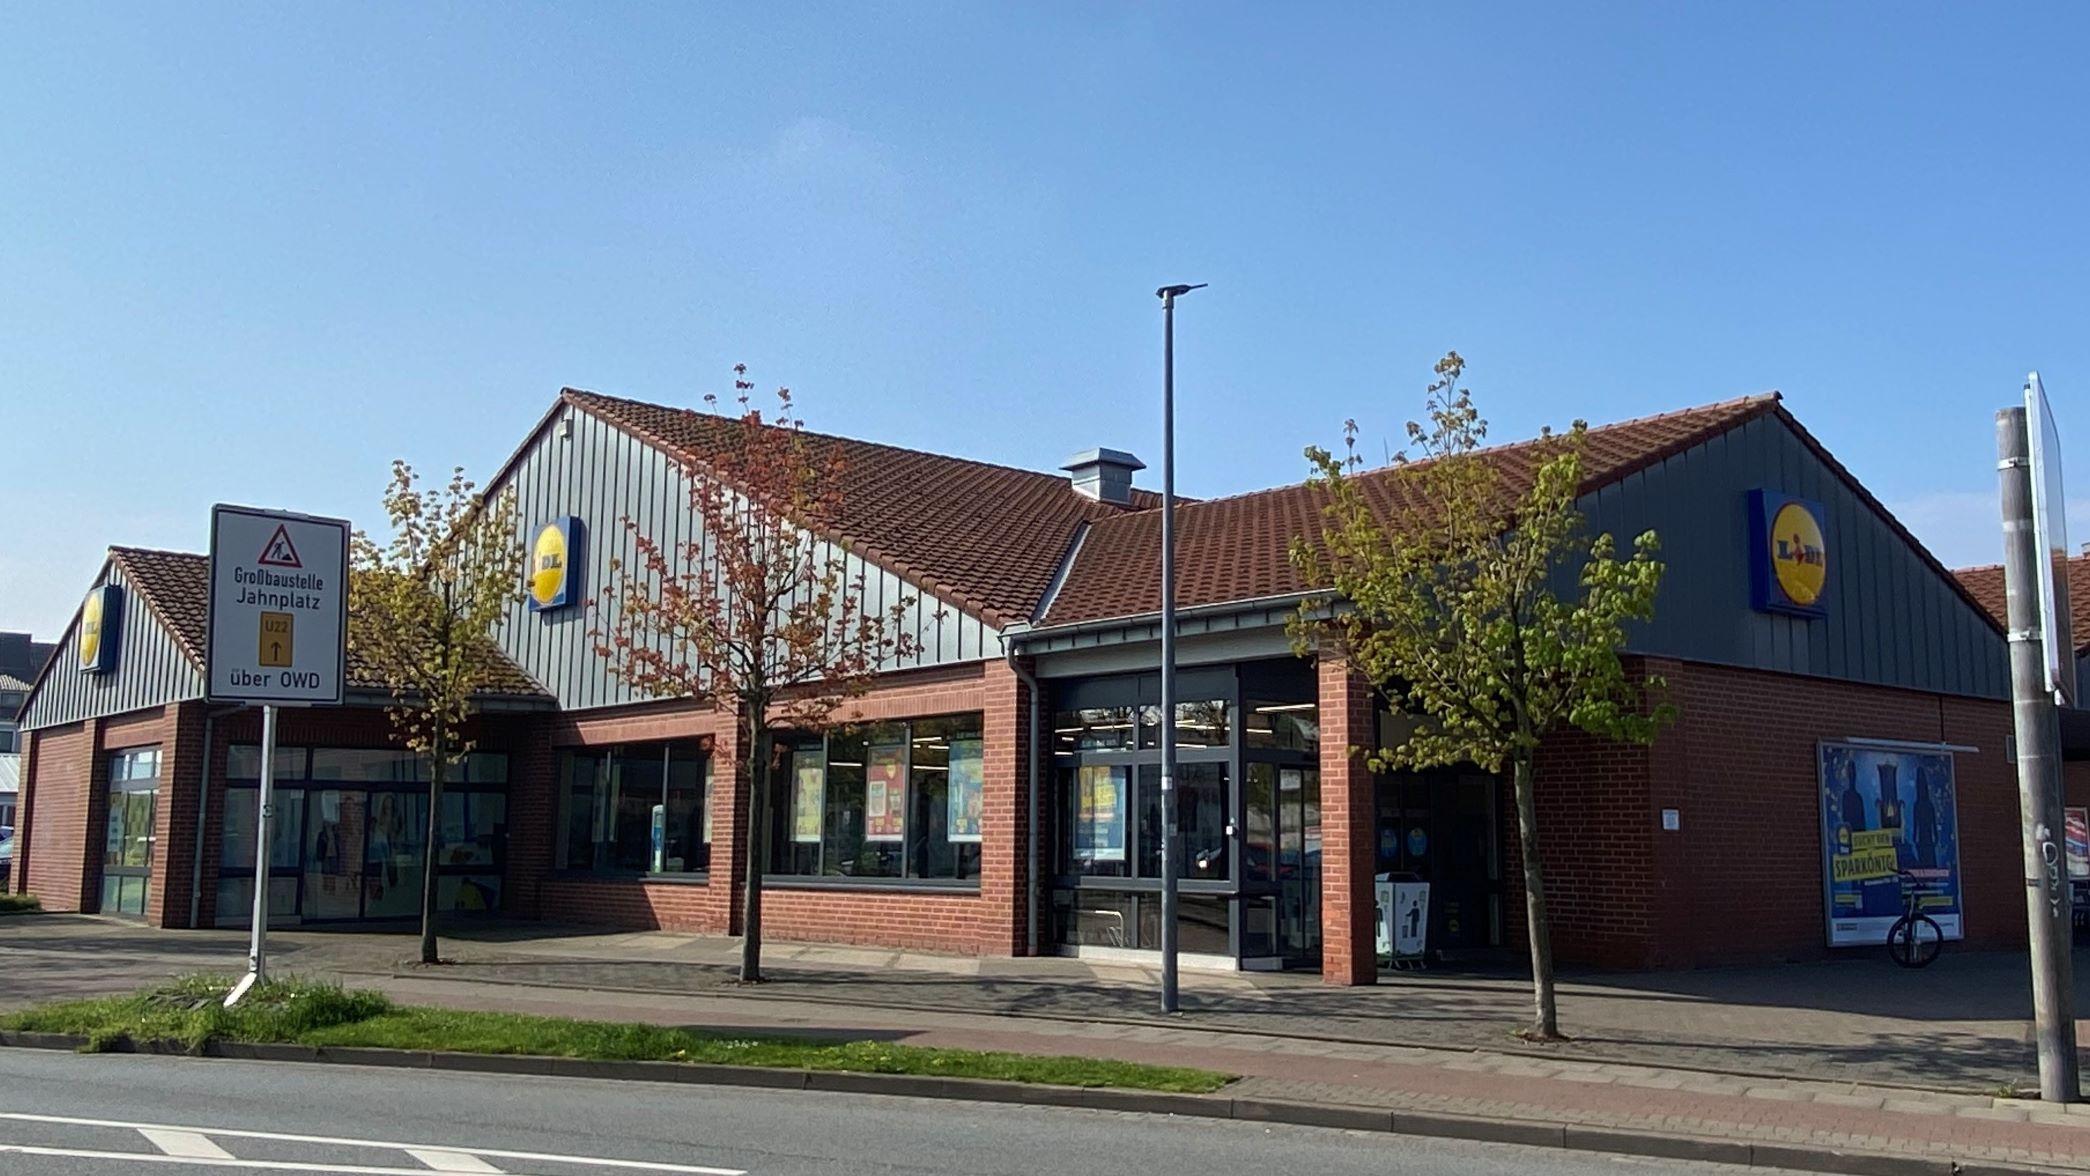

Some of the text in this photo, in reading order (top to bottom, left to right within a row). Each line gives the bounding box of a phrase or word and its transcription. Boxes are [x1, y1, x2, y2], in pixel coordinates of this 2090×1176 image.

[234, 566, 324, 591] Großbaustelle
[236, 587, 321, 611] Jahnplatz
[265, 619, 289, 633] U22
[230, 669, 320, 689] über OWD
[1835, 852, 1894, 878] SPARKÖNIG
